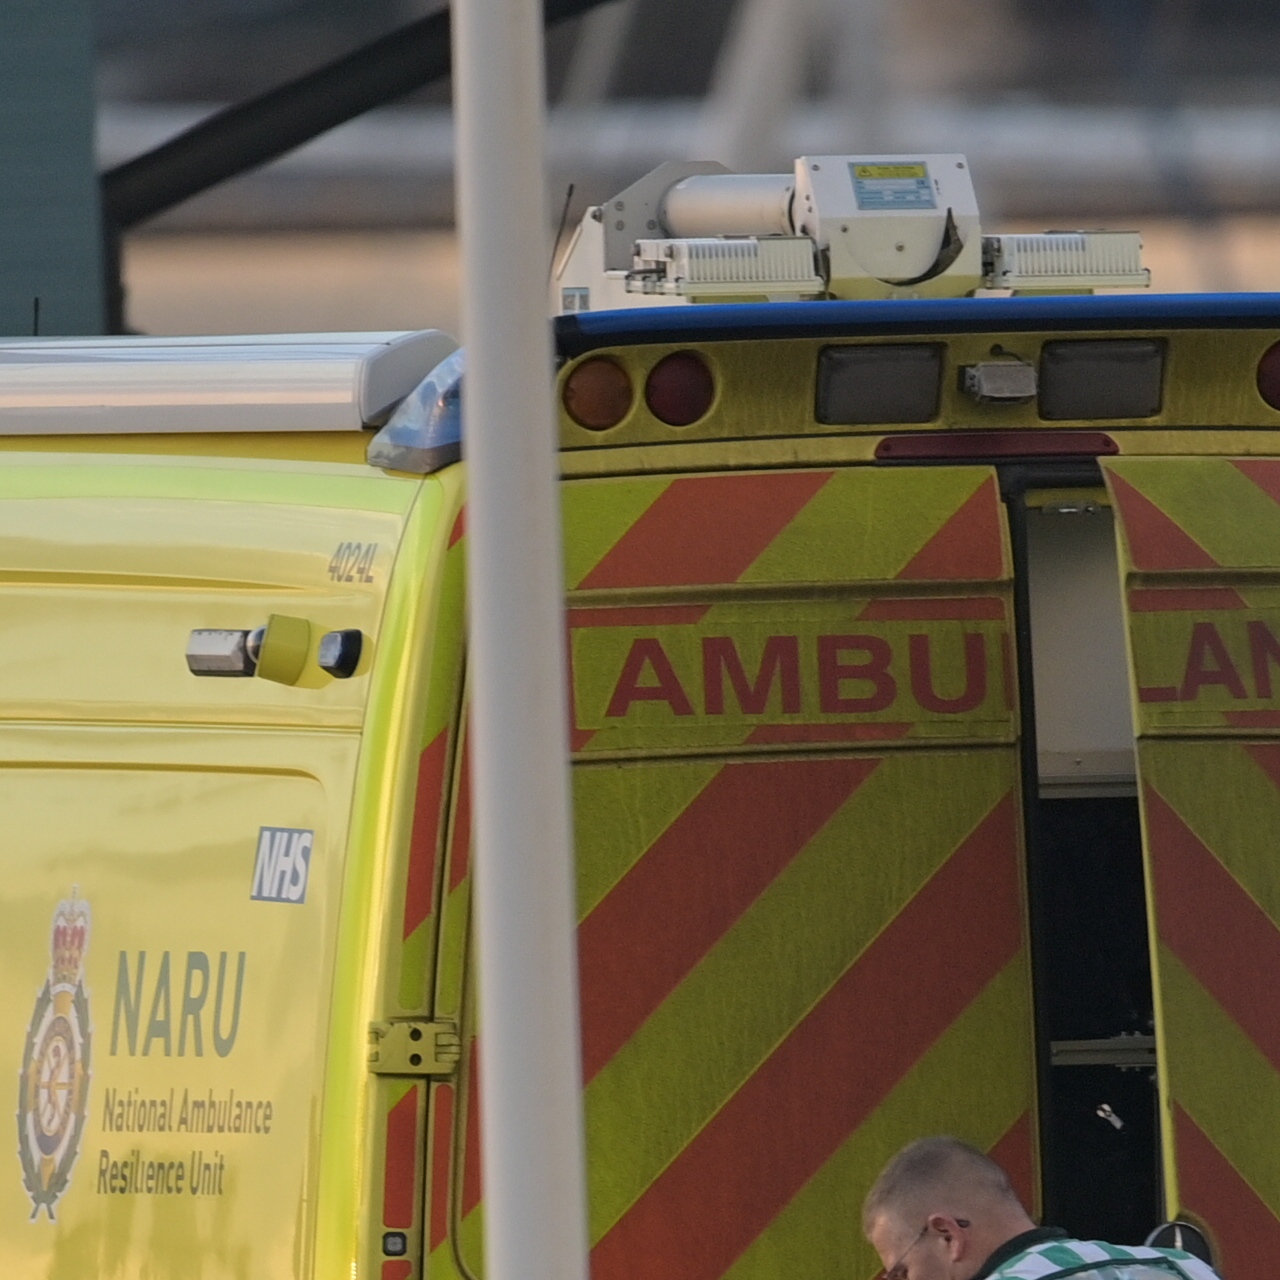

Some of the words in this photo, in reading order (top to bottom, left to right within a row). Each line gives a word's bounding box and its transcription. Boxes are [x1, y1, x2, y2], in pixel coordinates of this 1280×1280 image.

[252, 830, 313, 901] NHS
[109, 950, 246, 1058] NARU
[101, 1087, 175, 1133] National
[177, 1087, 273, 1135] Ambulance
[96, 1149, 185, 1195] Resilience
[189, 1150, 226, 1196] Unit
